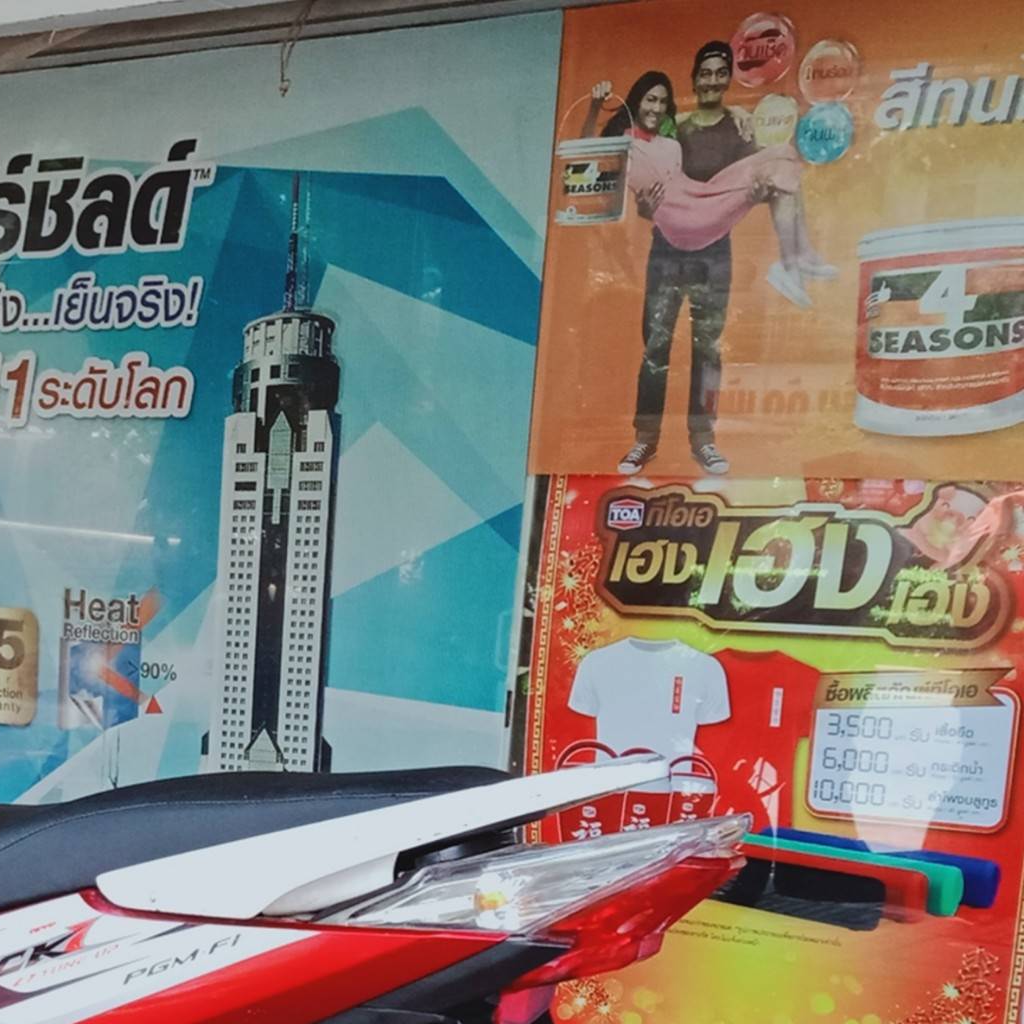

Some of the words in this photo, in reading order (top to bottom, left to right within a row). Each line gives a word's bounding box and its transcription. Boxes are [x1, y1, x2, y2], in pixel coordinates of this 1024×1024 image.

[869, 320, 1024, 354] SEASONS
[6, 359, 31, 419] 1
[38, 360, 187, 411] ระดับโลก
[613, 509, 641, 522] TOA
[645, 497, 714, 528] ทีโอเอ
[64, 587, 139, 624] Heat
[63, 622, 139, 644] Reflection
[828, 712, 893, 741] 3,500
[822, 746, 889, 775] 6,000
[814, 778, 886, 806] 10,000
